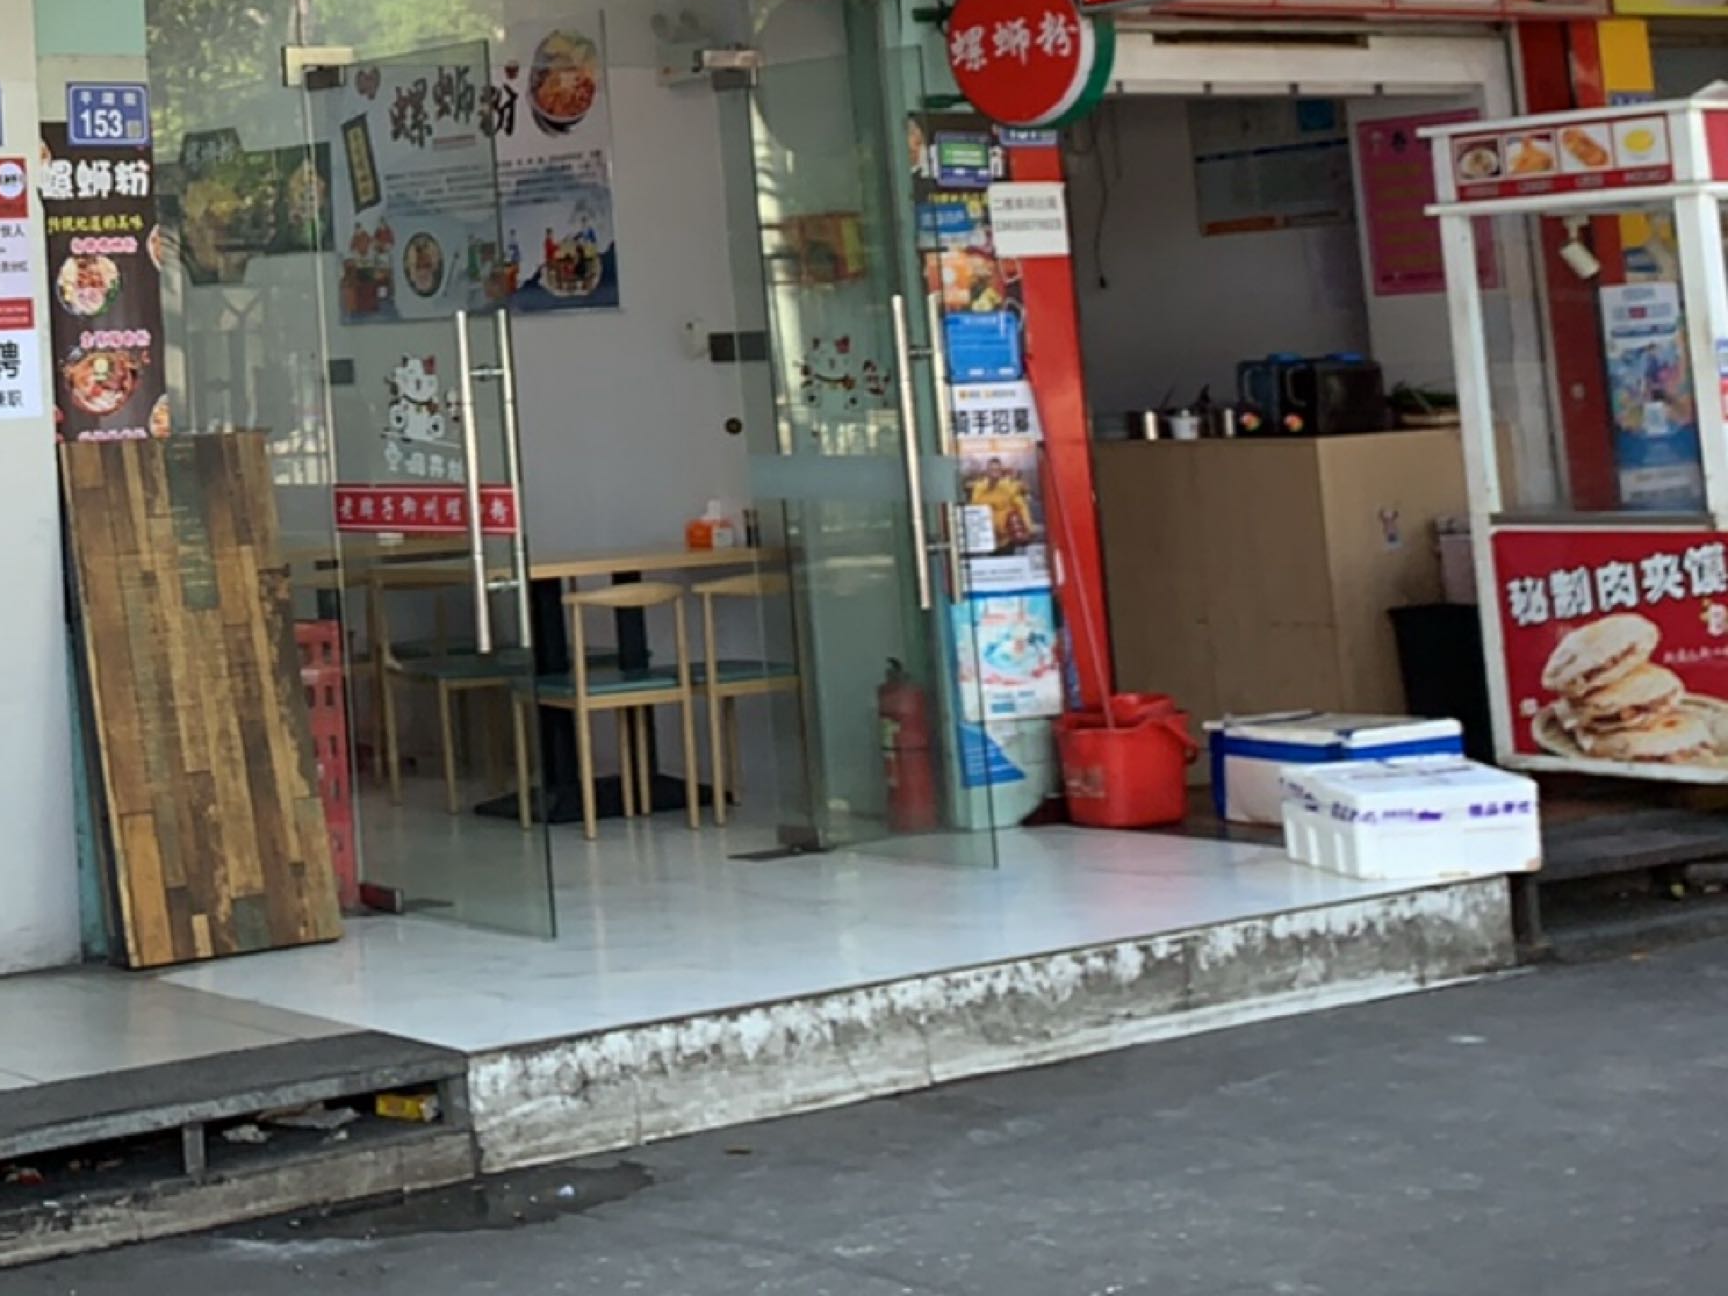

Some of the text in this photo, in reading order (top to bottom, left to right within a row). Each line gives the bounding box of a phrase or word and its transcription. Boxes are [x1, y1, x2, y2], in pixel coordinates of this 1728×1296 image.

[949, 10, 1079, 72] 螺蛳粉
[79, 108, 123, 139] 153
